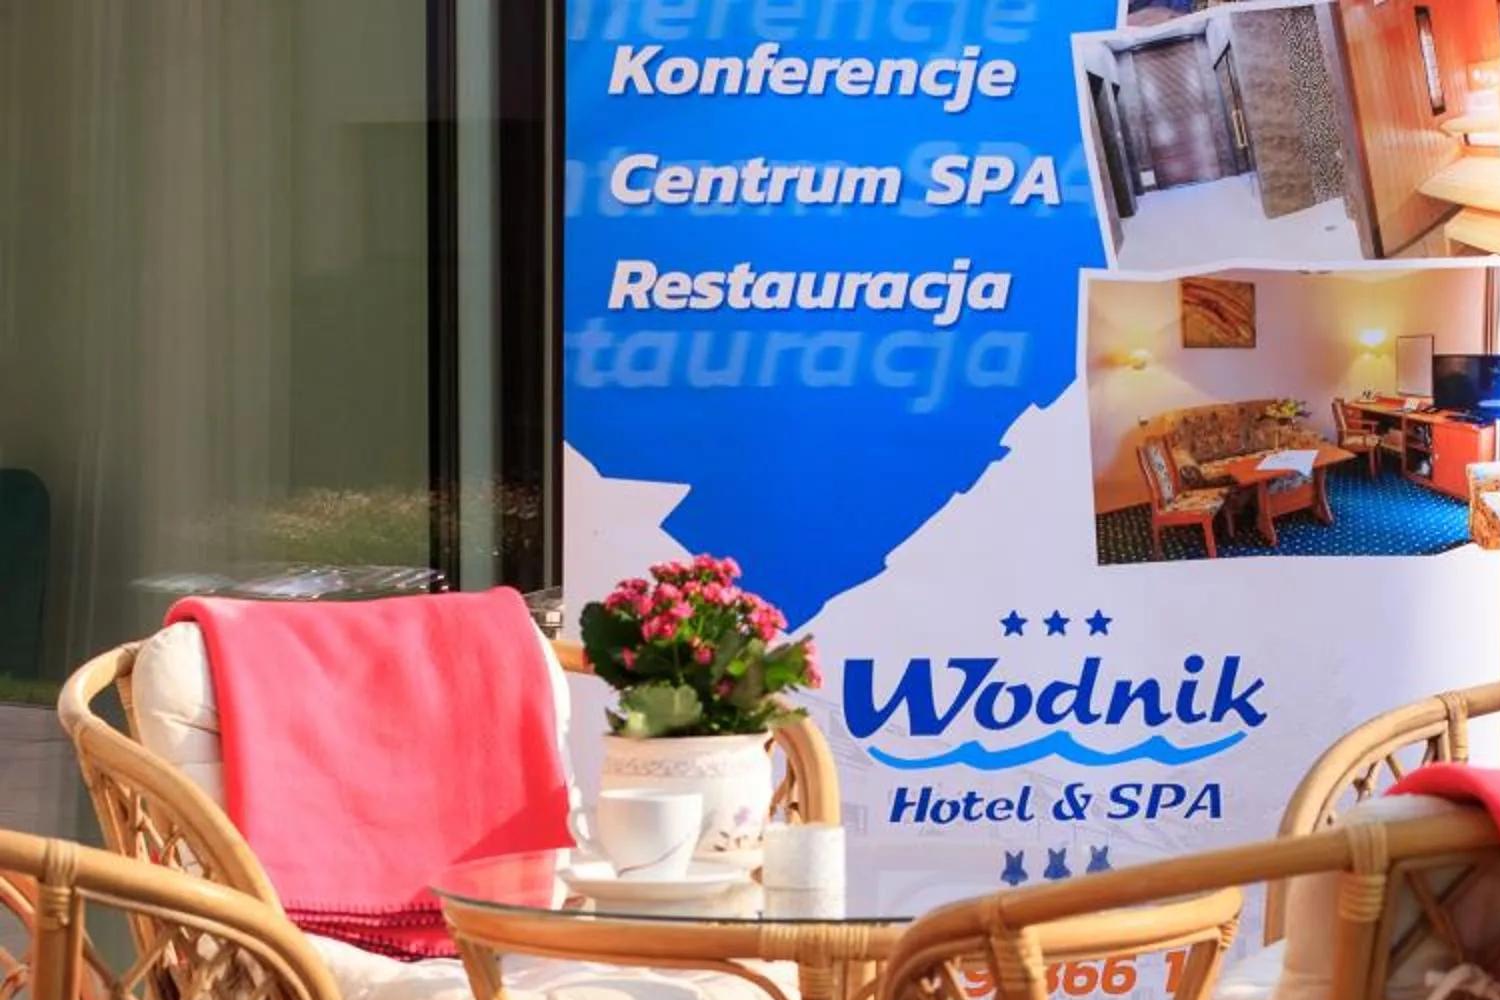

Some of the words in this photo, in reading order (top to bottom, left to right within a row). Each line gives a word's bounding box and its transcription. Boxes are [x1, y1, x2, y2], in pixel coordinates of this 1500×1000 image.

[608, 43, 1016, 112] Konferencje
[611, 155, 900, 202] Centrum
[927, 156, 1058, 203] SPA
[609, 260, 1009, 324] Restauracja
[565, 318, 1030, 414] tauracja
[843, 654, 1268, 739] Wodnik
[890, 786, 1034, 824] Hotel
[1053, 783, 1091, 821] &
[1108, 784, 1220, 819] SPA
